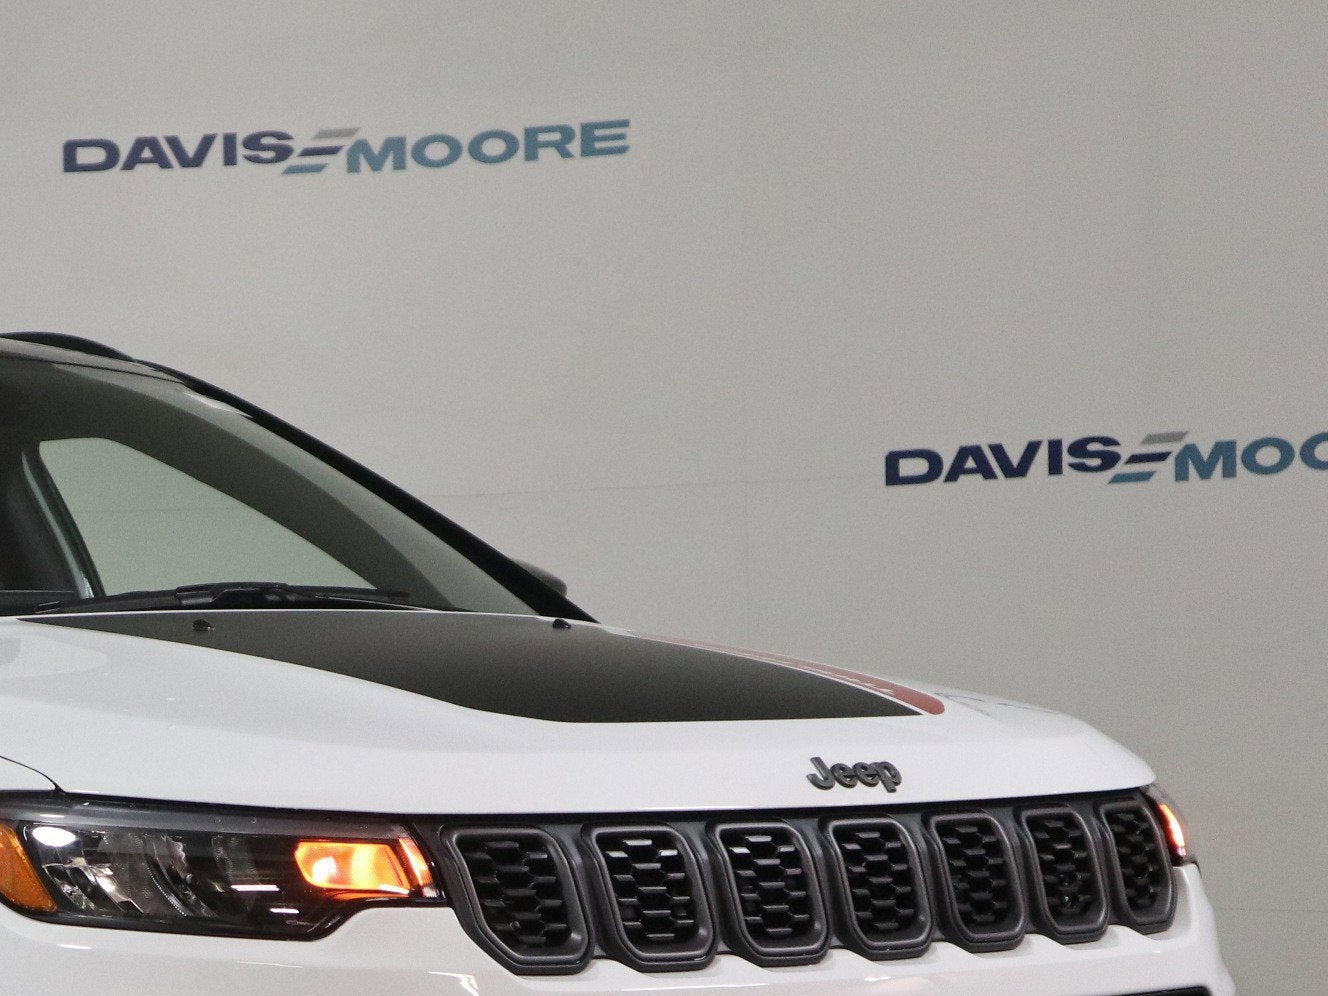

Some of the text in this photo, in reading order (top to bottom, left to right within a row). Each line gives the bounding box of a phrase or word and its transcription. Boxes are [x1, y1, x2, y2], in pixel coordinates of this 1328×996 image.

[62, 119, 630, 174] DAVIS MOORE
[885, 436, 1122, 486] DAVIS
[806, 756, 902, 793] Jeep
